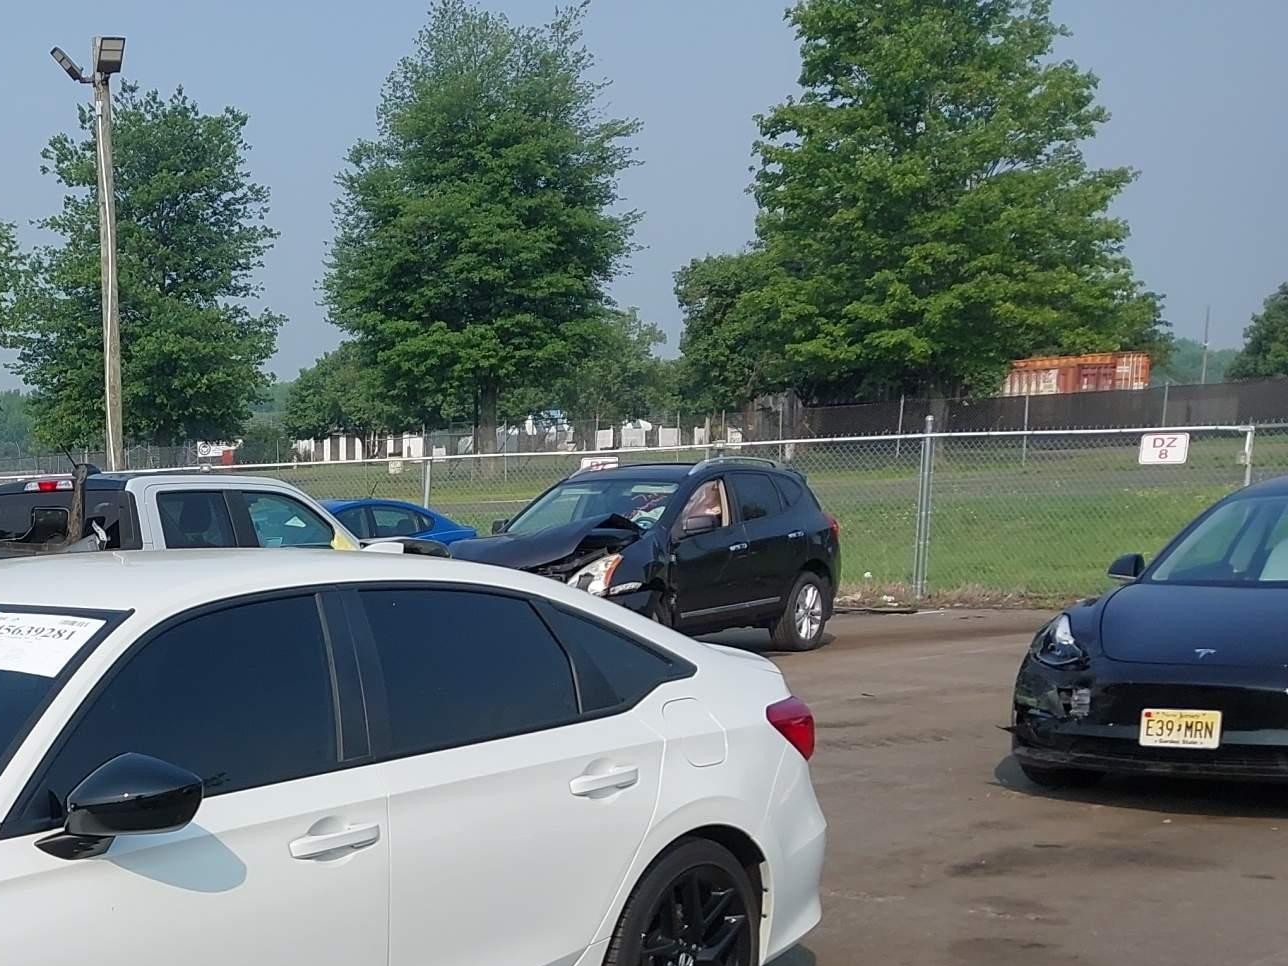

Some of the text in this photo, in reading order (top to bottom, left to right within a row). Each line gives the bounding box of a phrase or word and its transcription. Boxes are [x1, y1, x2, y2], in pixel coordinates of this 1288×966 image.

[1152, 437, 1177, 448] DZ
[1158, 449, 1168, 459] 8
[1145, 719, 1214, 739] E39 MRN
